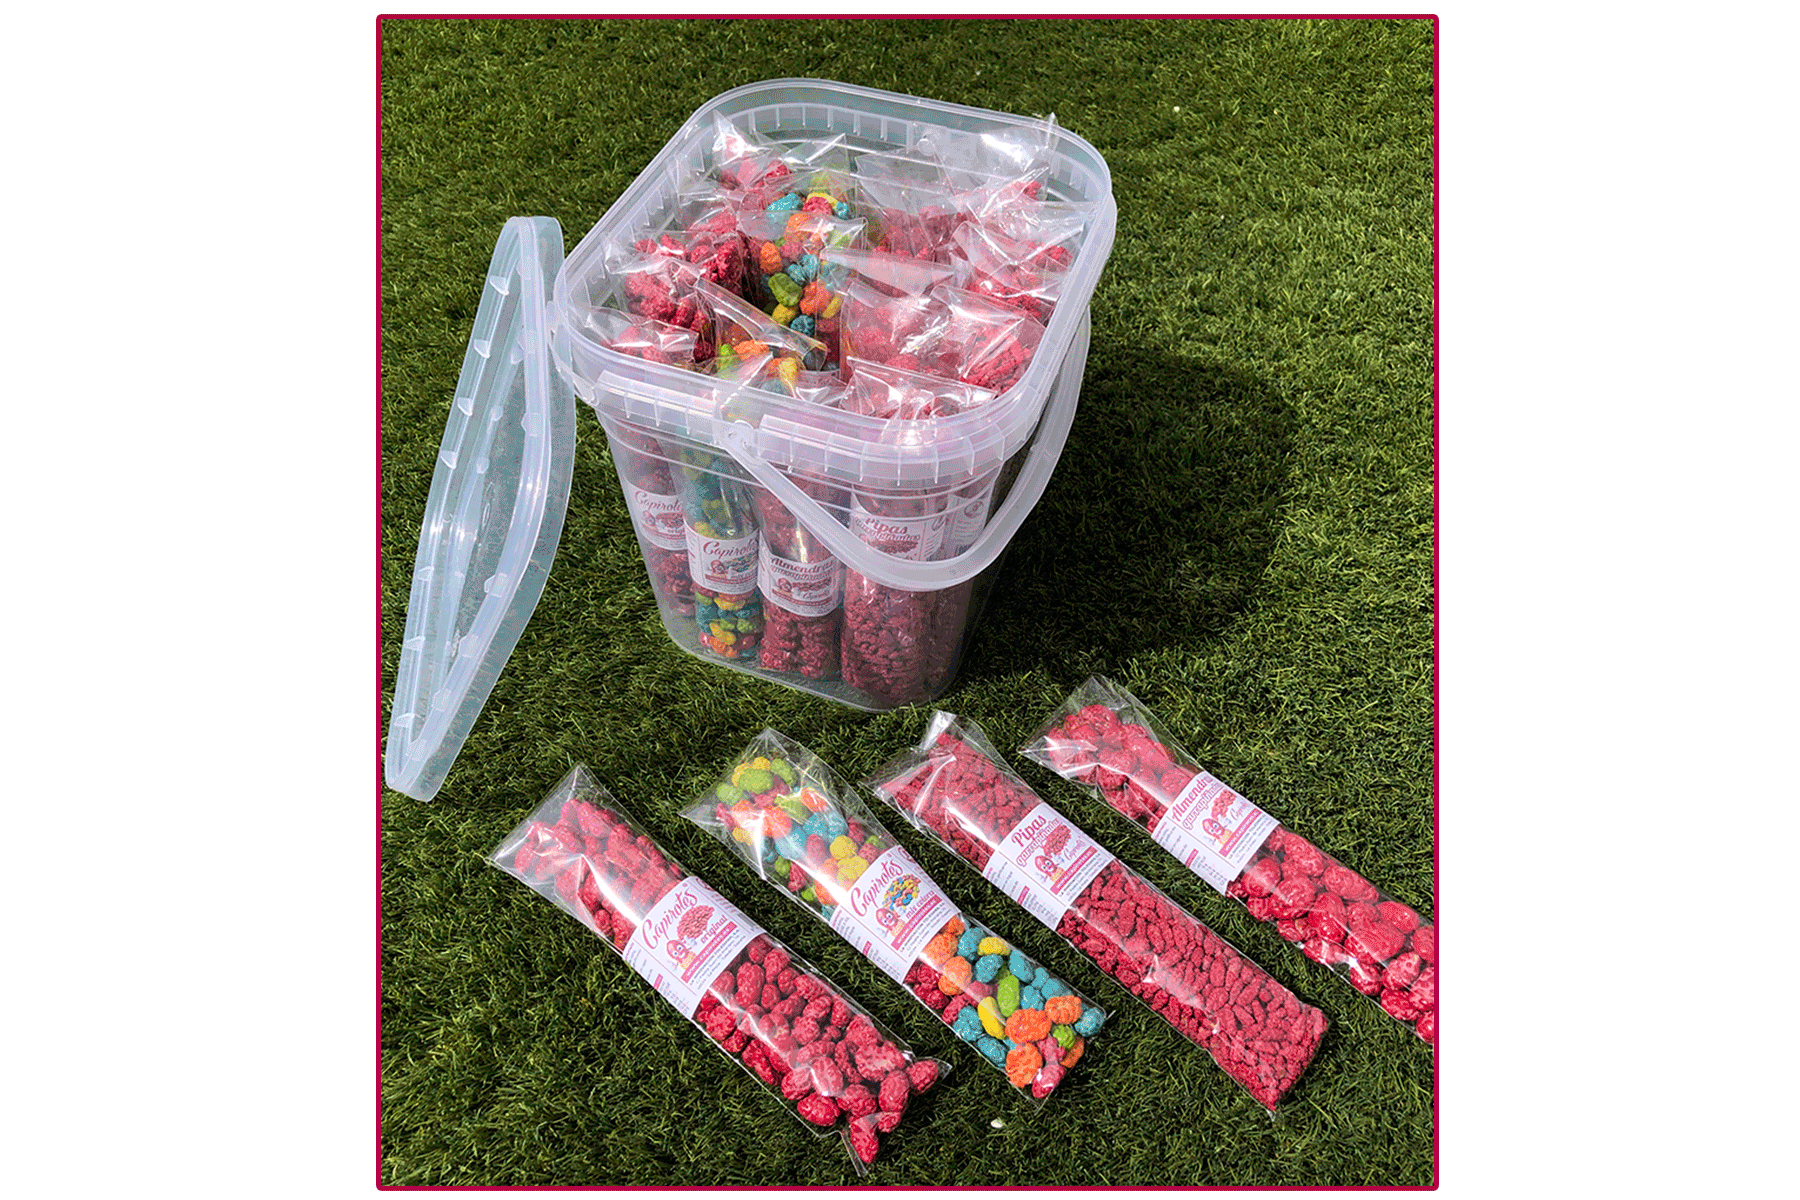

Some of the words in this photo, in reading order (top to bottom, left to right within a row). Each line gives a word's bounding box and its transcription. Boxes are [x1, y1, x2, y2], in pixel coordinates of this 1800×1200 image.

[866, 517, 908, 535] Pipas
[703, 538, 758, 560] Capirot
[1010, 814, 1047, 848] Pipas
[1015, 817, 1063, 868] garrapiñada
[850, 859, 904, 918] Capirotes
[641, 888, 698, 950] Capirotes
[699, 914, 728, 945] original
